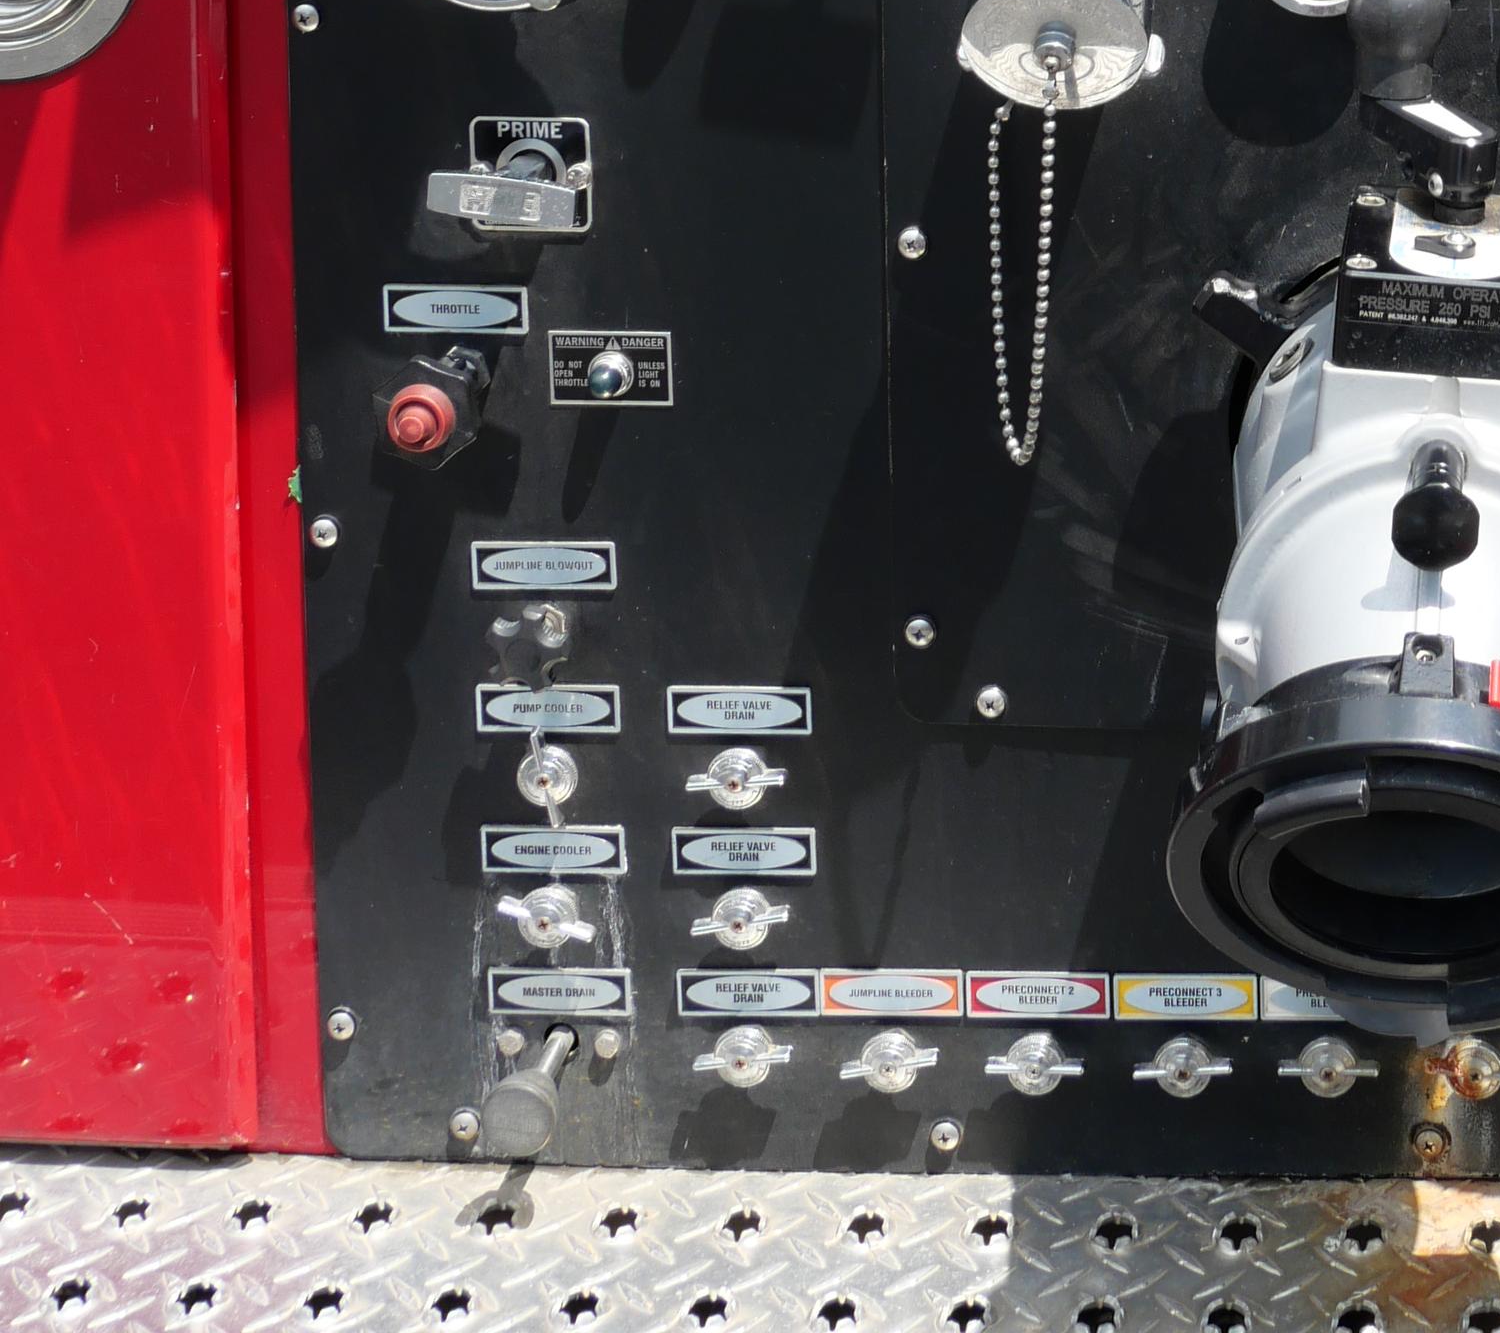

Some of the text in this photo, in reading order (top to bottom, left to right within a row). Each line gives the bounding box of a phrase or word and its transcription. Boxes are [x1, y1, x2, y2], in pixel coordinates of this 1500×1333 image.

[497, 122, 563, 139] PRIME
[1381, 281, 1444, 299] MAXIMUM
[430, 304, 480, 314] THROTTLE
[1359, 296, 1429, 313] PRESSURE
[1439, 304, 1461, 316] 250
[1470, 305, 1490, 318] PSI
[555, 336, 664, 348] WARNING DANGER
[554, 361, 583, 369] DO NOT
[638, 362, 665, 370] UNLESS
[554, 370, 573, 378] OPEN
[638, 371, 659, 379] LIGHT
[554, 379, 588, 387] THROTTLE
[638, 380, 661, 388] IS ON
[494, 561, 594, 571] JUMPLINE BLOWOUT
[512, 704, 584, 714] PUMP COOLER
[706, 700, 772, 710] RELIEF VALVE
[724, 711, 755, 721] DRAIN
[514, 845, 592, 856] ENGINE COOLER
[711, 841, 776, 852] RELIEF VALVE
[728, 852, 759, 862] DRAIN
[522, 987, 595, 998] MASTER DRAIN
[715, 983, 781, 993] RELIEF VALVE
[1001, 985, 1075, 996] PRECONNECT 2
[1149, 987, 1222, 997] PRECONNECT 3
[733, 993, 764, 1003] DRAIN
[849, 989, 933, 998] JUMPLINE BLEEDER
[1018, 995, 1058, 1005] BLEEDER
[1164, 997, 1207, 1008] BLEEDER
